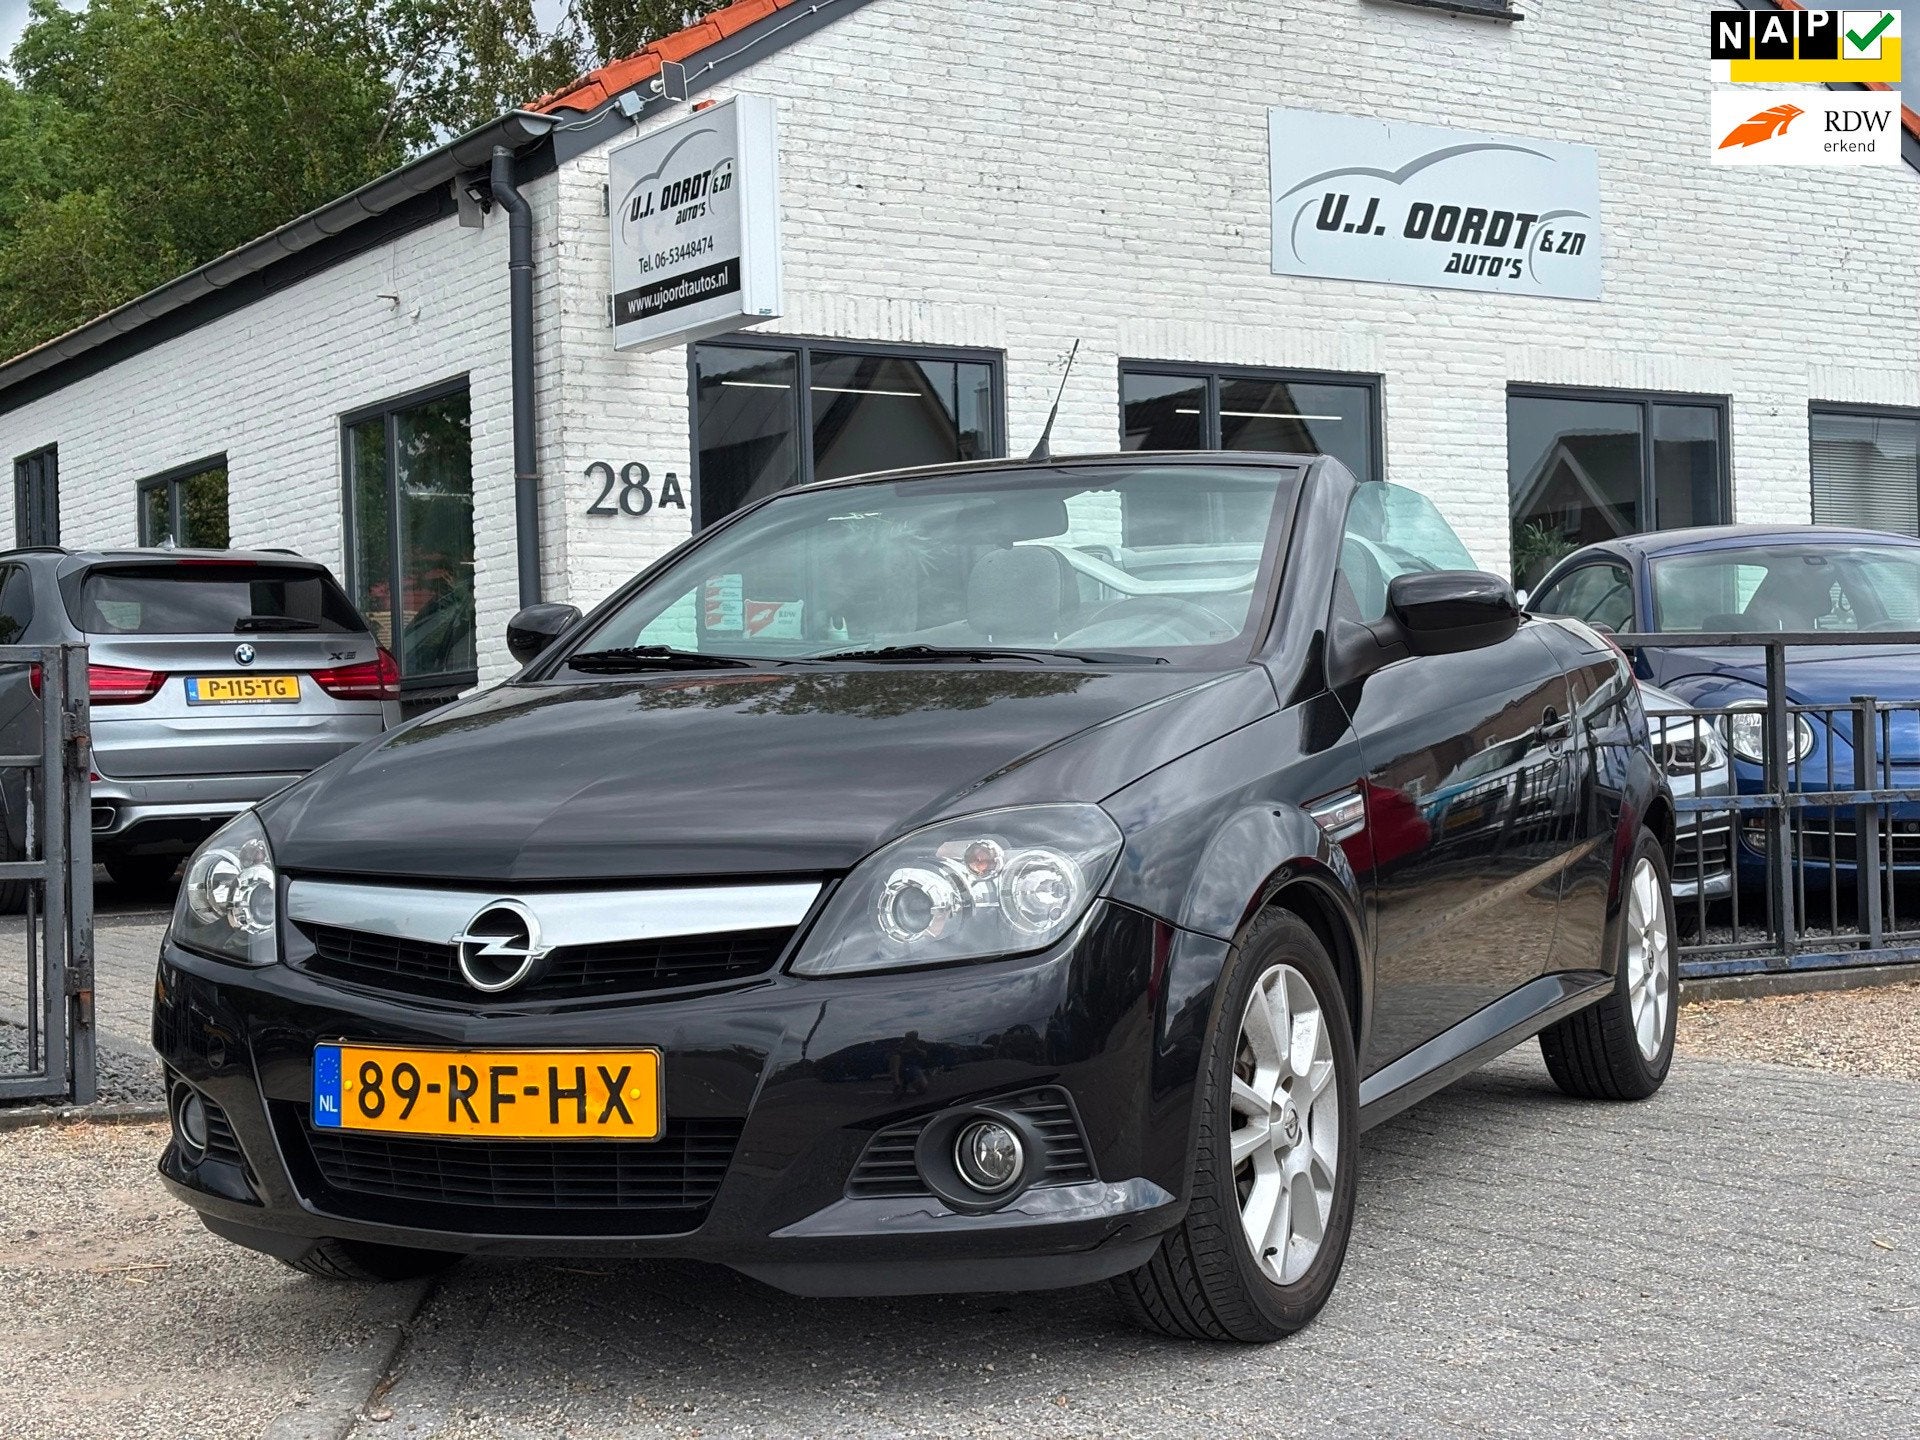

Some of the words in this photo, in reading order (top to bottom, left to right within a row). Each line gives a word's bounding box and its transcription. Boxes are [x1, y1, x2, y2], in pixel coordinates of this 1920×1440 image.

[630, 191, 655, 222] U.J.
[660, 169, 712, 211] OORDT
[1315, 192, 1386, 236] U.J.
[1403, 202, 1539, 250] OORDT
[638, 254, 654, 275] Tel.
[655, 235, 714, 270] 06-53448474
[627, 265, 729, 314] www.ujoordtautos.nl
[208, 679, 287, 697] P-115-TG
[319, 1095, 338, 1112] NL
[357, 1060, 634, 1125] 89-RF-HX
